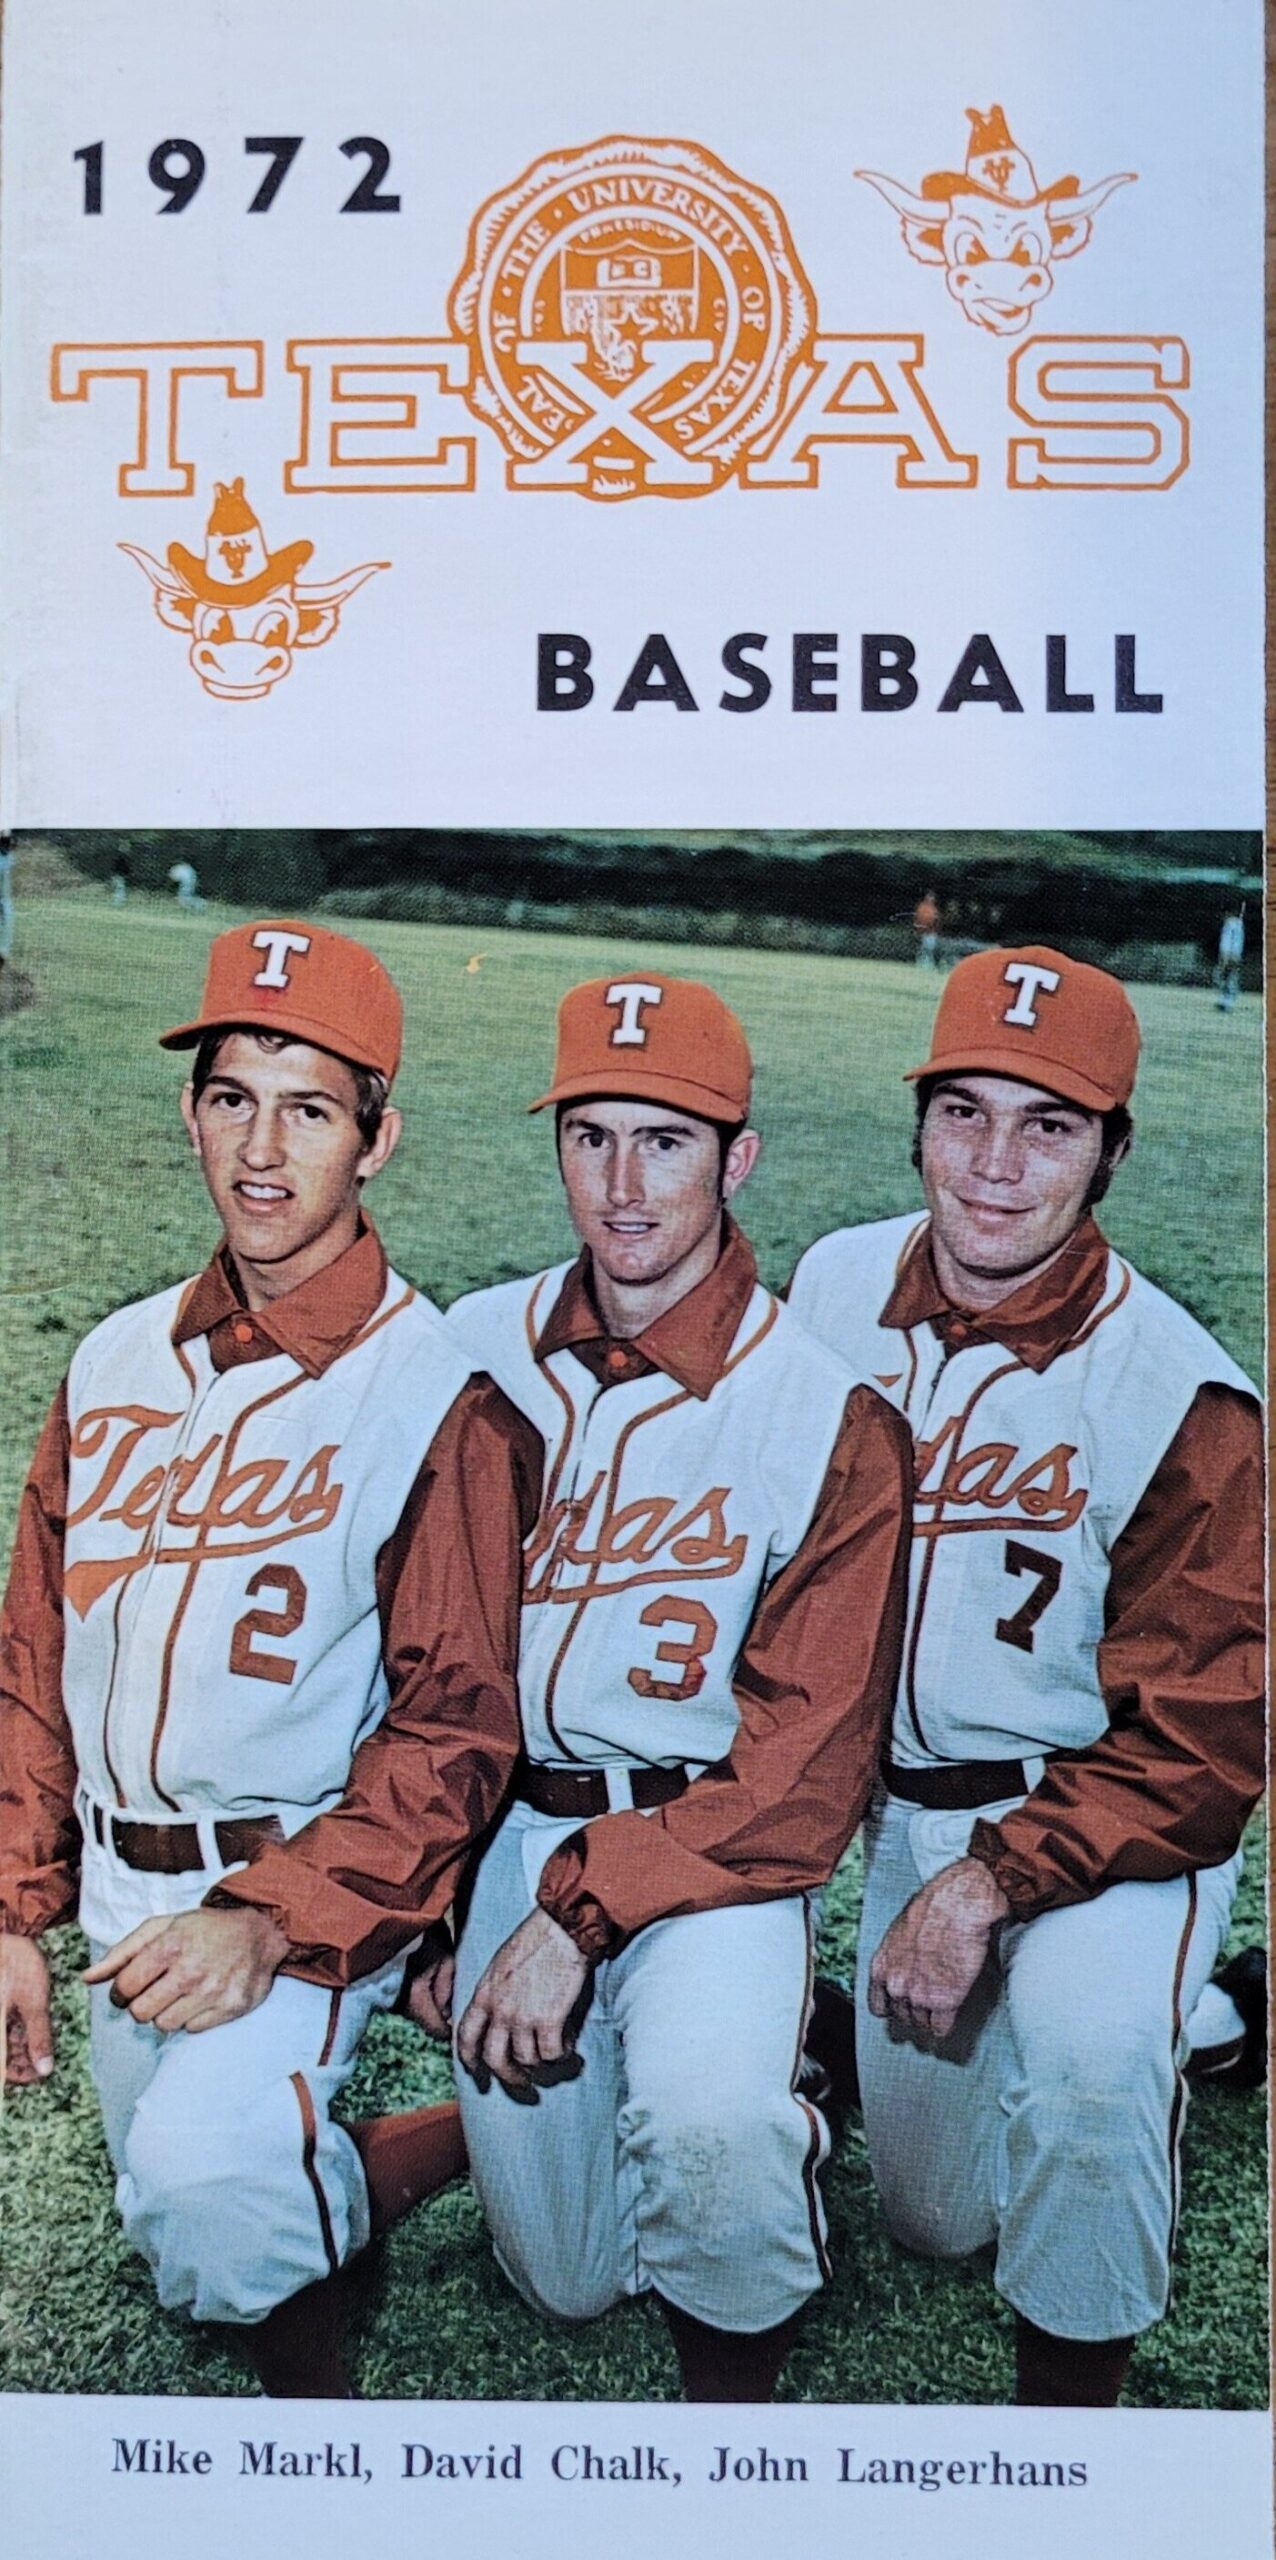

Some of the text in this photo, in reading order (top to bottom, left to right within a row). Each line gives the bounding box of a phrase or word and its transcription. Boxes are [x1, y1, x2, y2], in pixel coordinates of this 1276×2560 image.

[74, 136, 401, 215] 1972
[502, 220, 551, 281] THE
[566, 178, 750, 256] UNIVERSITY
[741, 286, 766, 331] OF
[51, 334, 1191, 496] TEXAS
[516, 374, 575, 433] EAL
[673, 358, 757, 440] TEXAS
[536, 632, 1165, 714] BASEBALL
[252, 930, 310, 988] T
[1003, 961, 1061, 1027] T
[605, 982, 662, 1045] T
[66, 1404, 343, 1564] Texas
[230, 1563, 307, 1684] 2
[995, 1538, 1063, 1652] 7
[627, 1594, 719, 1701] 3
[112, 2438, 1088, 2492] Mike Markl, David Chalk, John Langerhans
